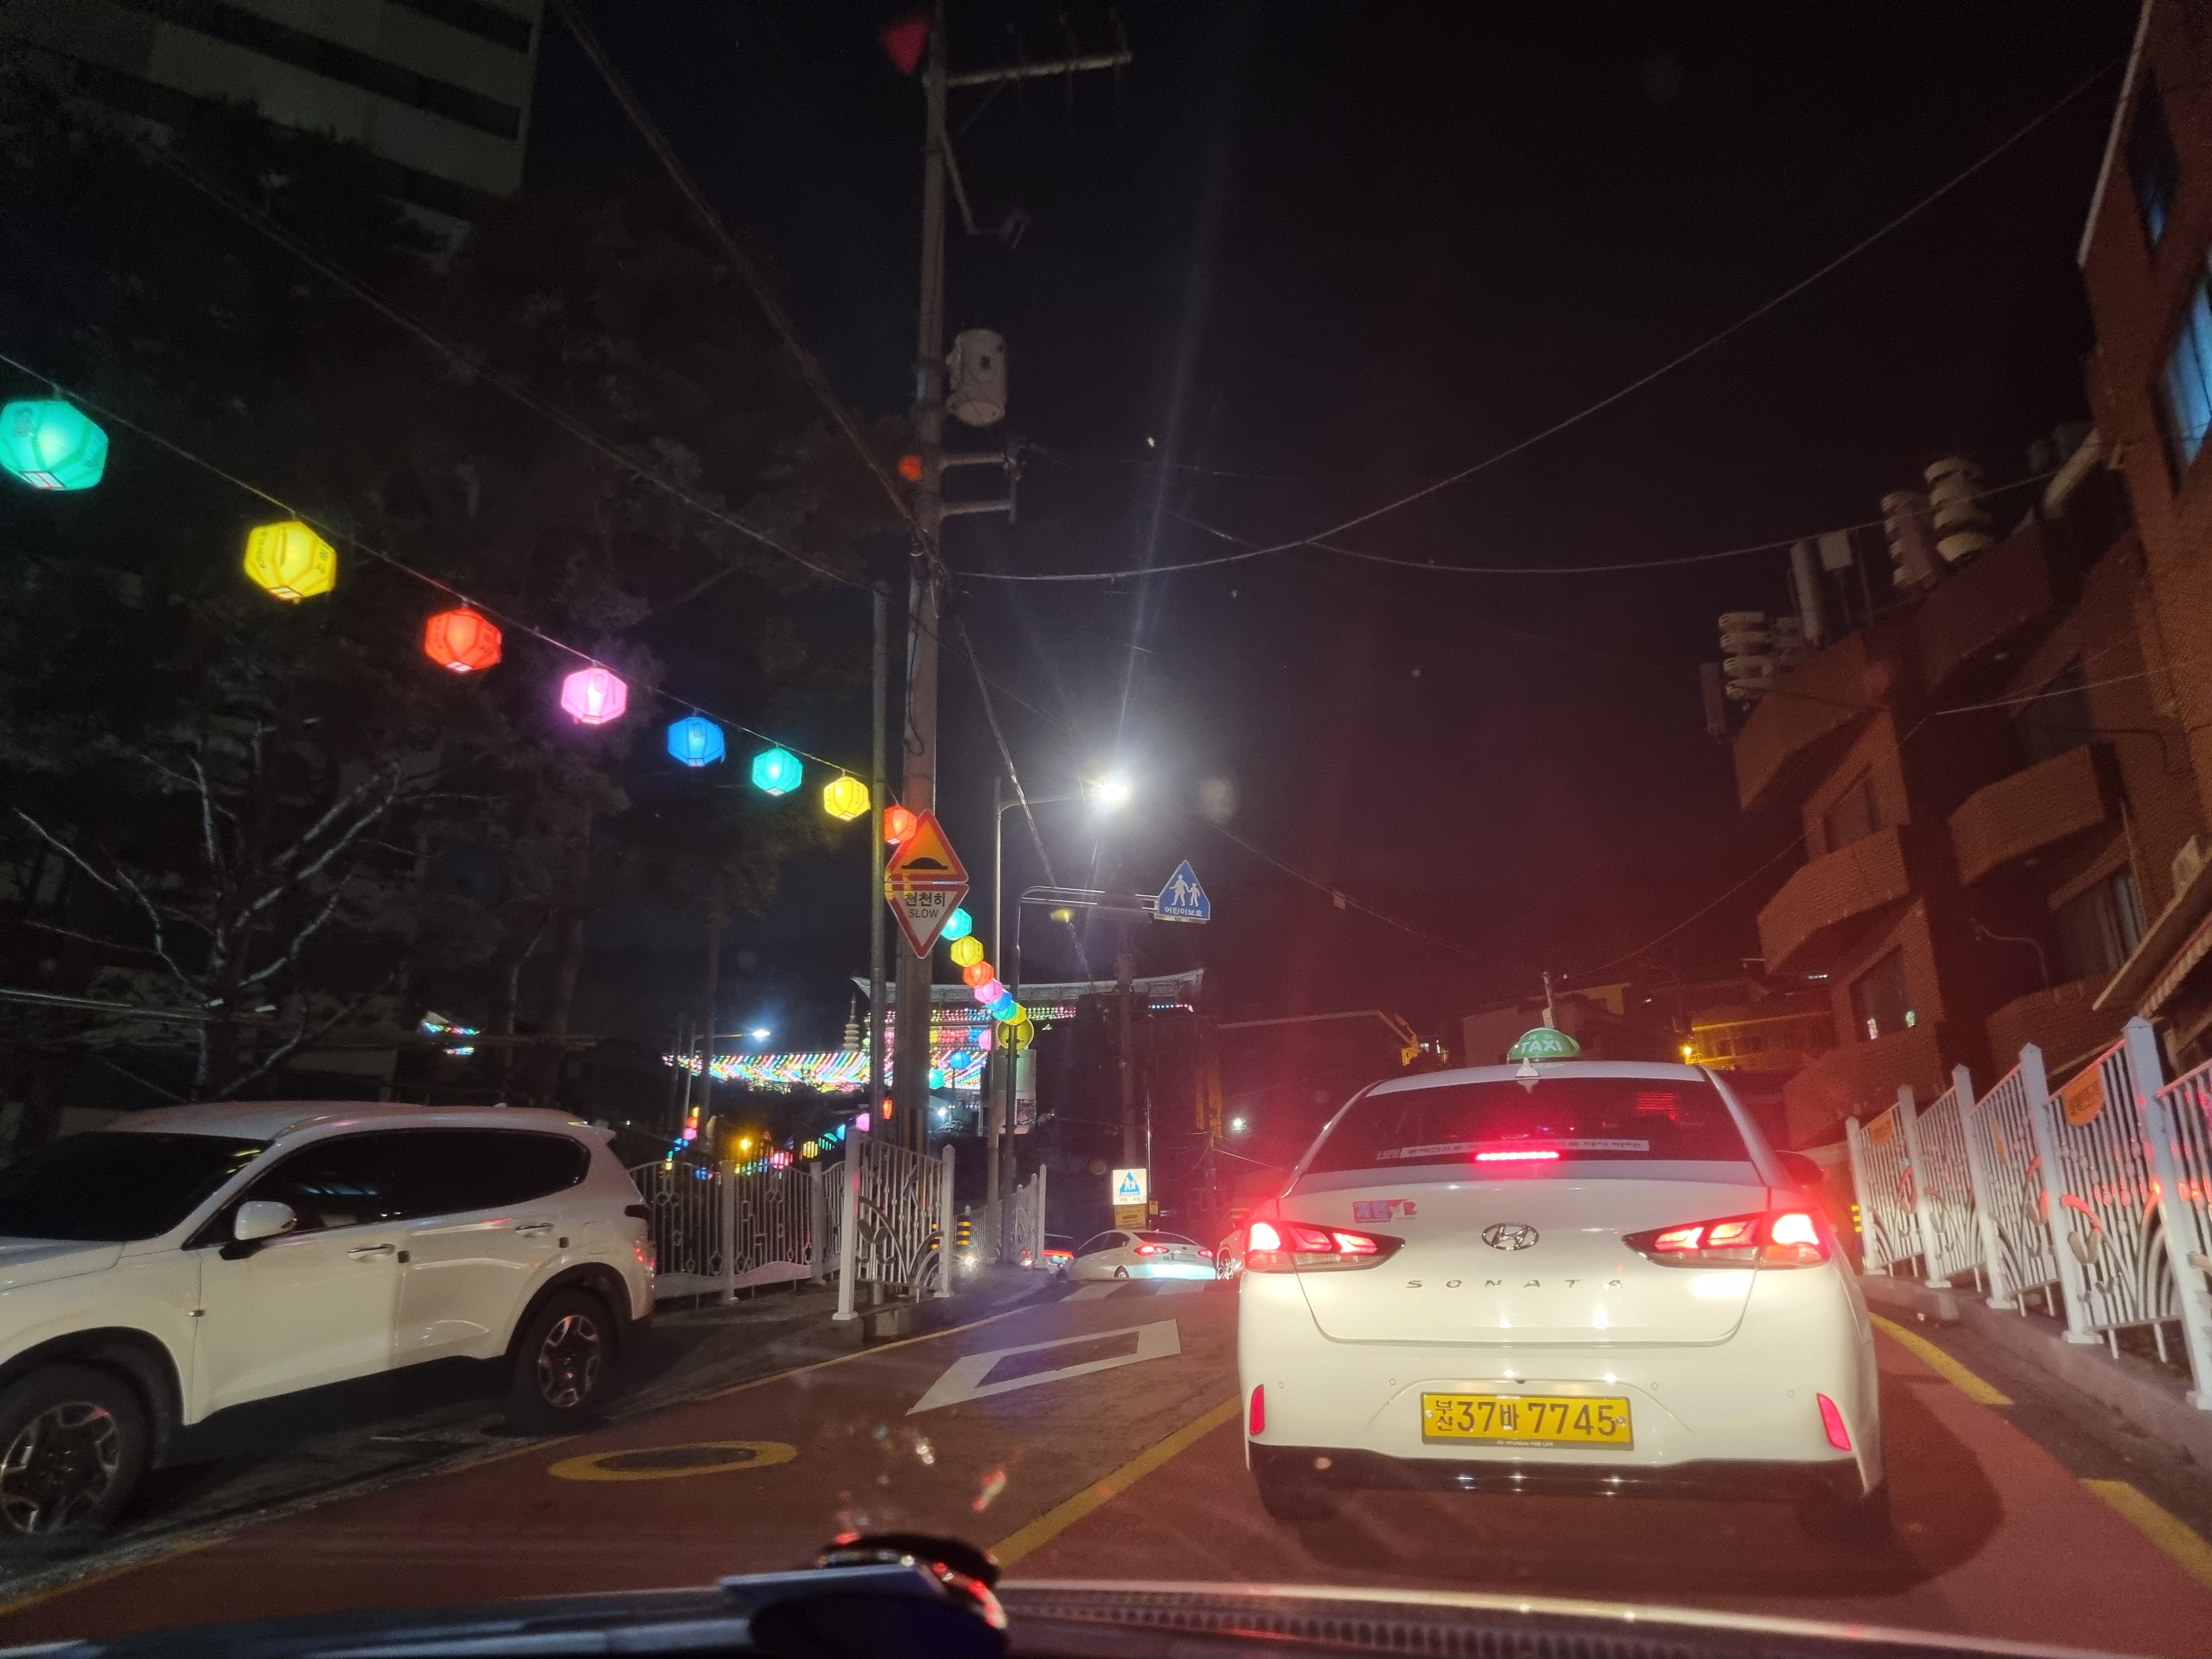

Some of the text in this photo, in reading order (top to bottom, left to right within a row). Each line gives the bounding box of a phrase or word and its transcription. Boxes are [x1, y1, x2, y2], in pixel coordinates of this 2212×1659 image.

[905, 892, 945, 906] 천천히
[909, 909, 939, 918] SLOW
[1165, 906, 1203, 917] 어린이보호
[1521, 1040, 1562, 1053] TAXI
[1406, 1279, 1623, 1288] SONATA
[1528, 1402, 1616, 1436] 7745
